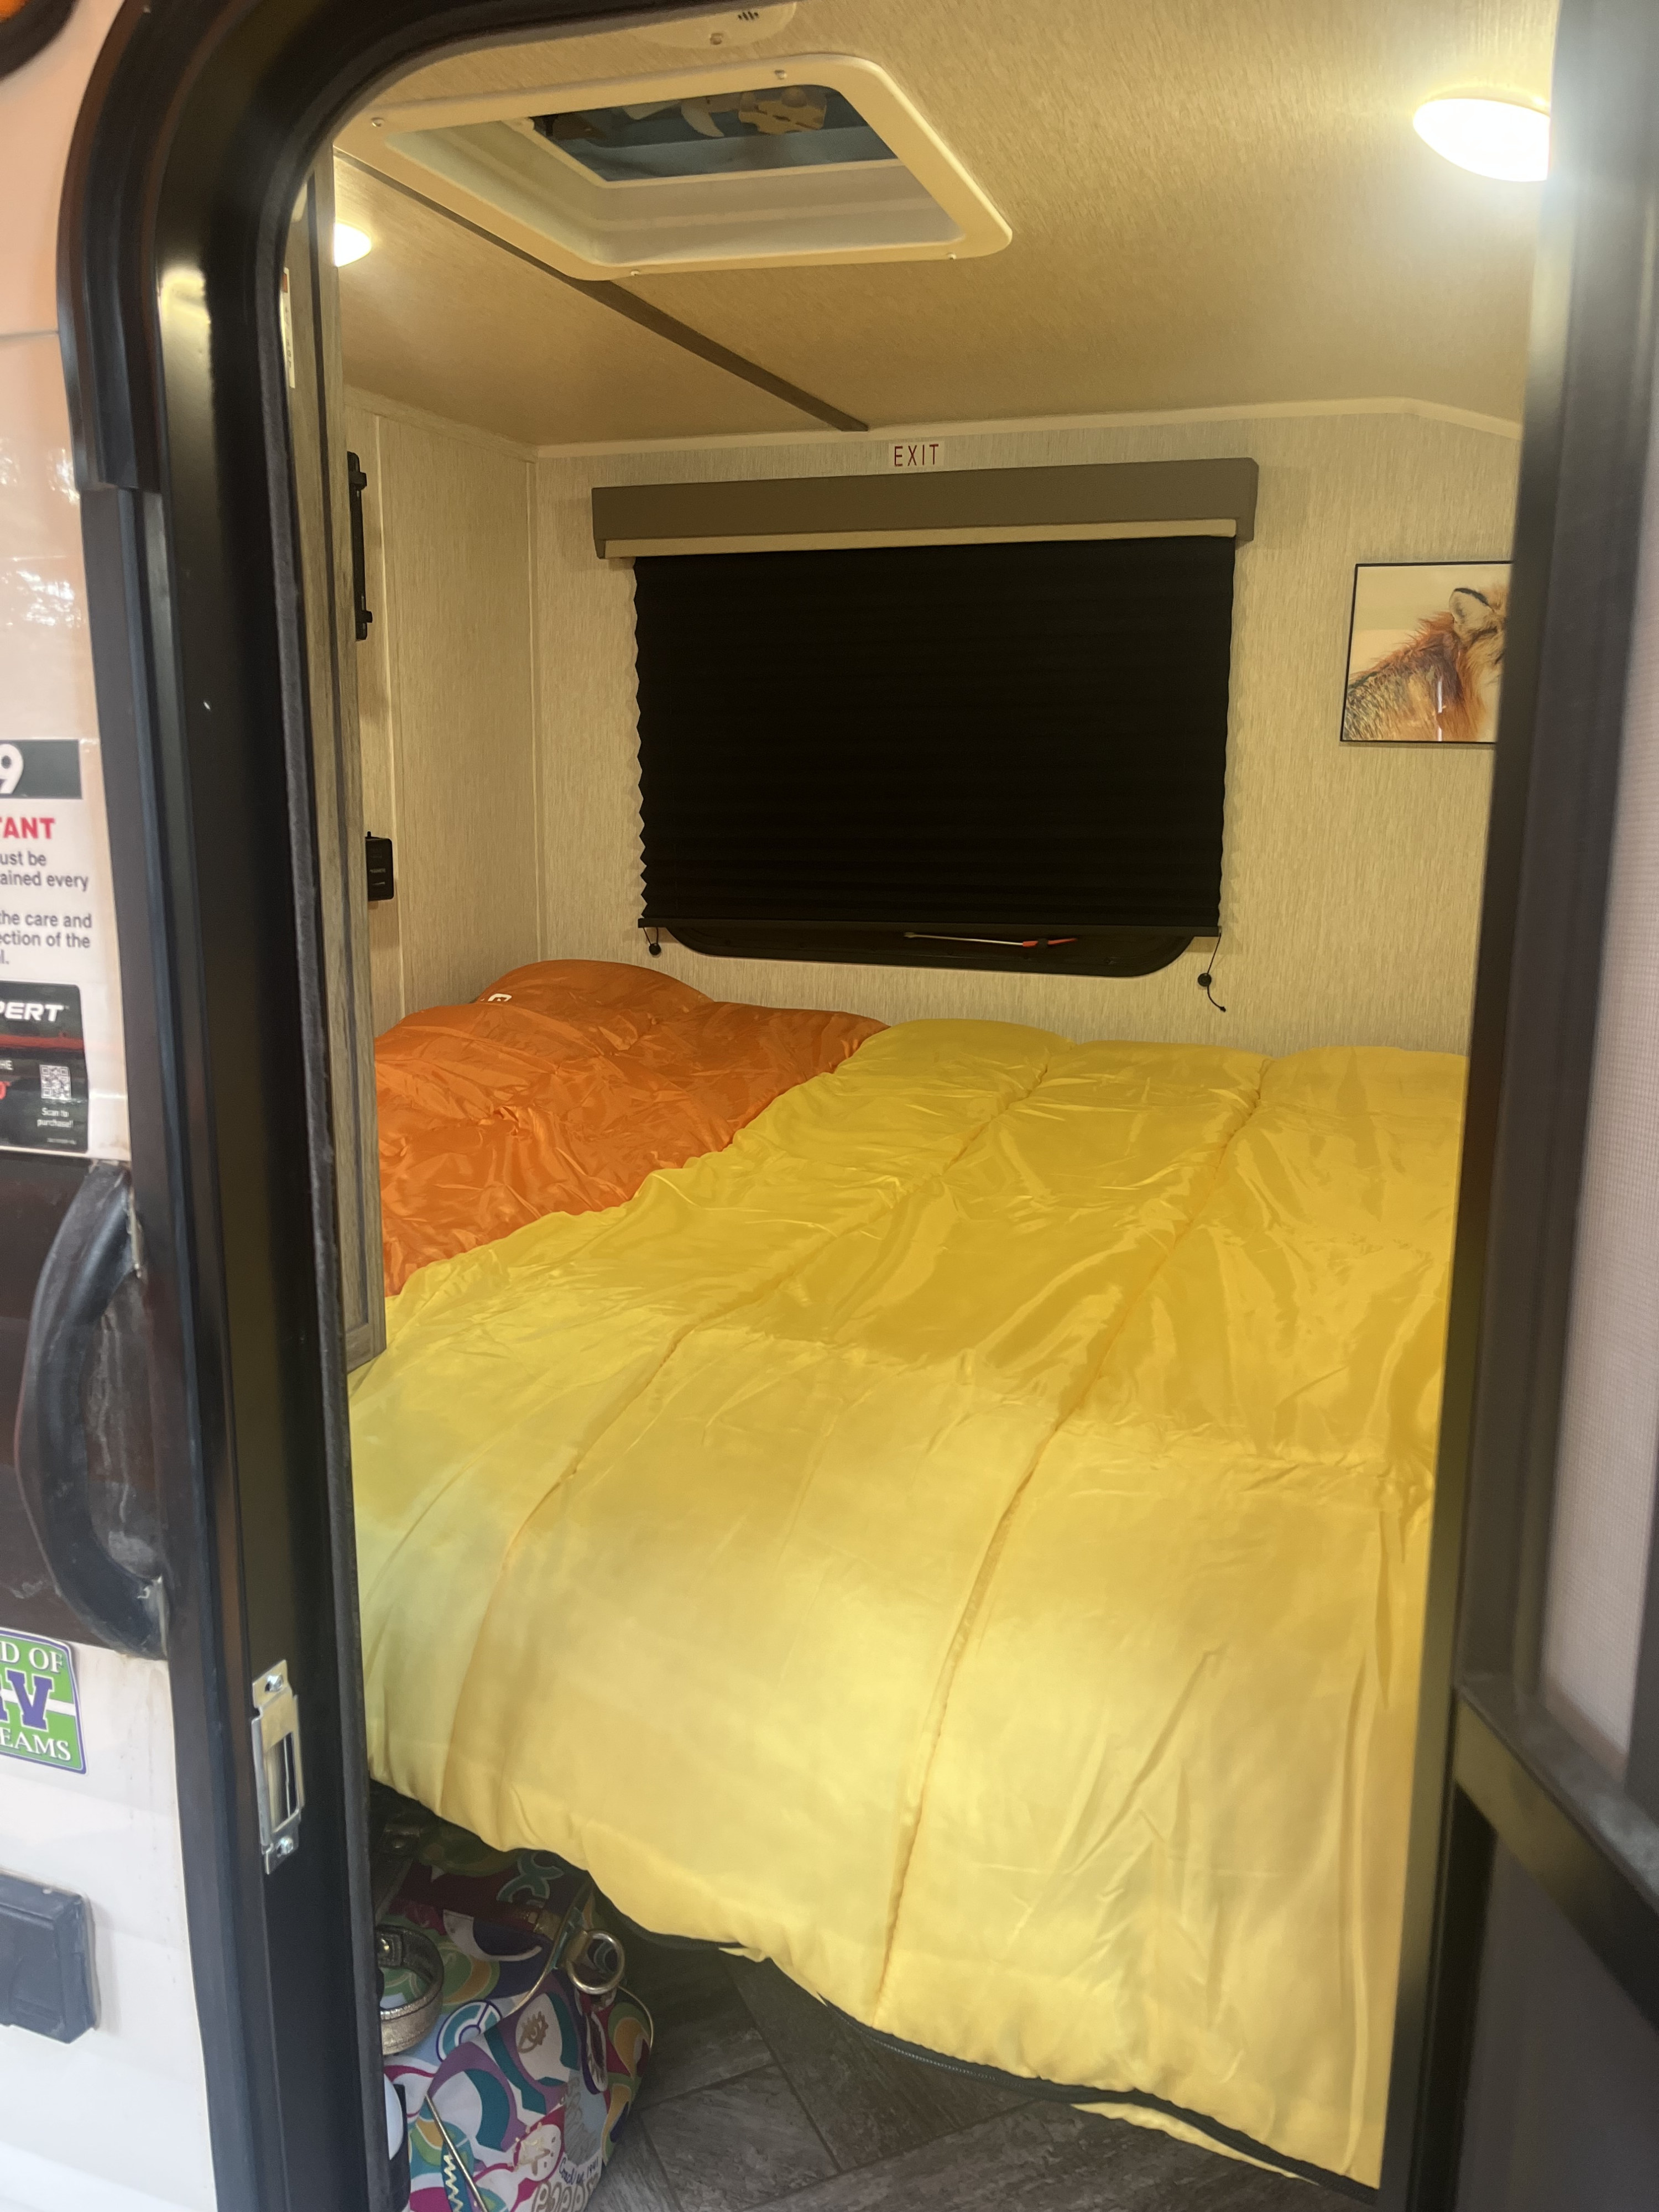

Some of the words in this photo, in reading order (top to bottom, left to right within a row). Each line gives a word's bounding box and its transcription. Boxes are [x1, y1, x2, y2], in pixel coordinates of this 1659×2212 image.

[894, 444, 939, 467] EXIT
[0, 817, 55, 839] ANT
[28, 851, 46, 867] be
[46, 875, 88, 892] every
[25, 914, 58, 927] care
[63, 914, 92, 928] and
[46, 932, 61, 947] of
[66, 933, 90, 948] the
[29, 1648, 62, 1672] OF
